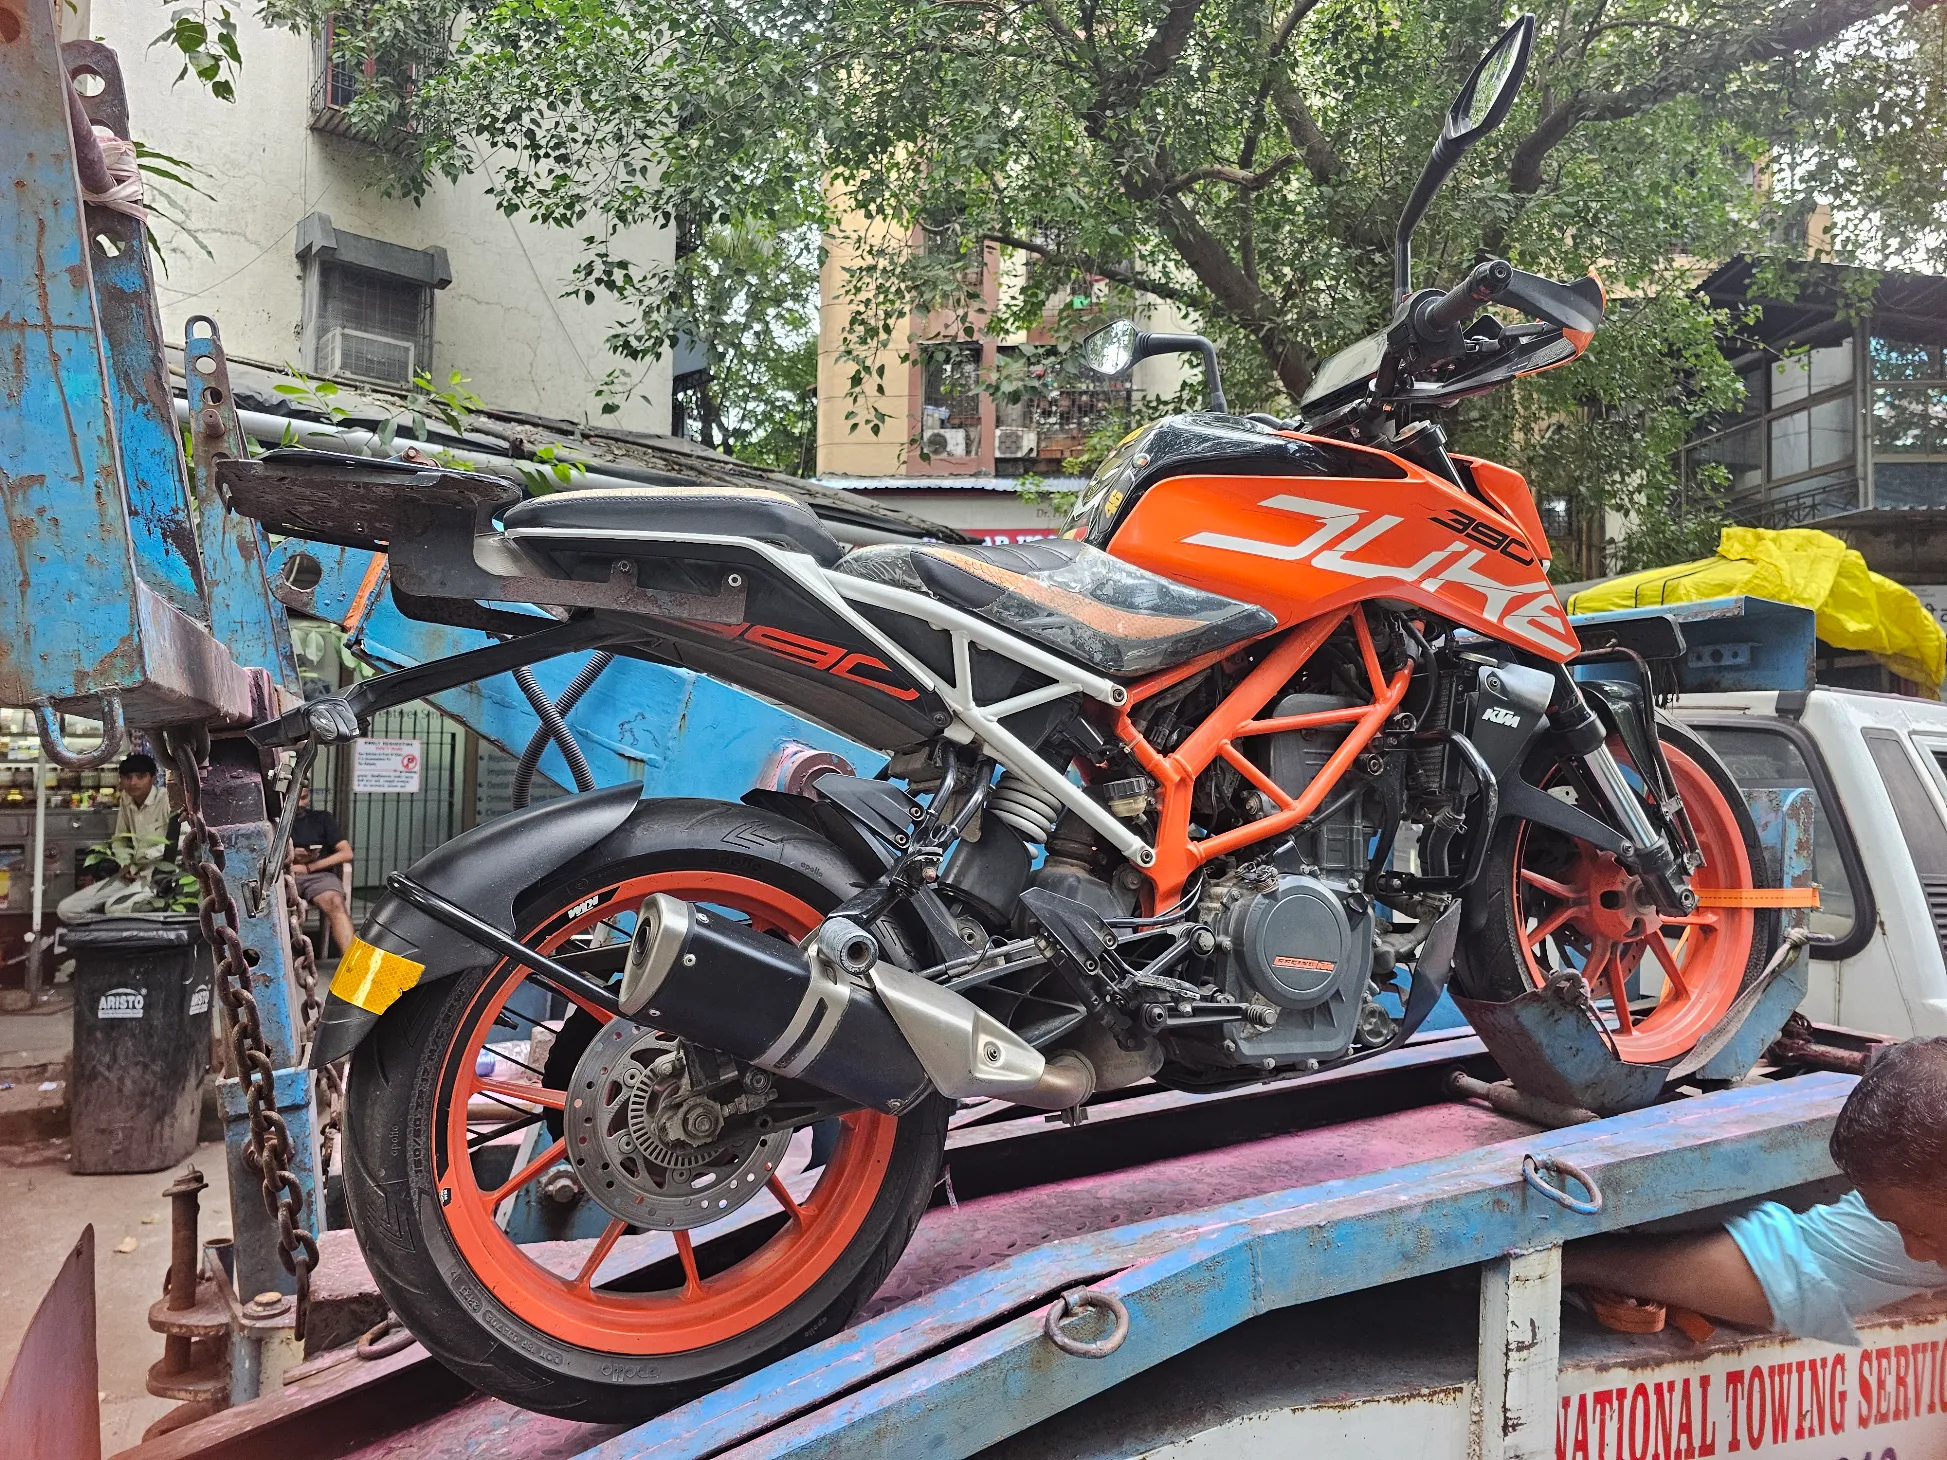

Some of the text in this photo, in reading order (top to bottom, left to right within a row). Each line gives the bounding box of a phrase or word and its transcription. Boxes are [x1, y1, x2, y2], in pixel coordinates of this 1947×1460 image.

[1427, 509, 1534, 566] 390
[1481, 706, 1520, 728] KTM
[800, 861, 824, 878] apollo
[99, 994, 144, 1010] ARISTO
[390, 1124, 400, 1158] apollo
[601, 1362, 661, 1383] apollo
[1556, 1374, 1716, 1460] NATIONAL
[1726, 1352, 1848, 1453] TOWING
